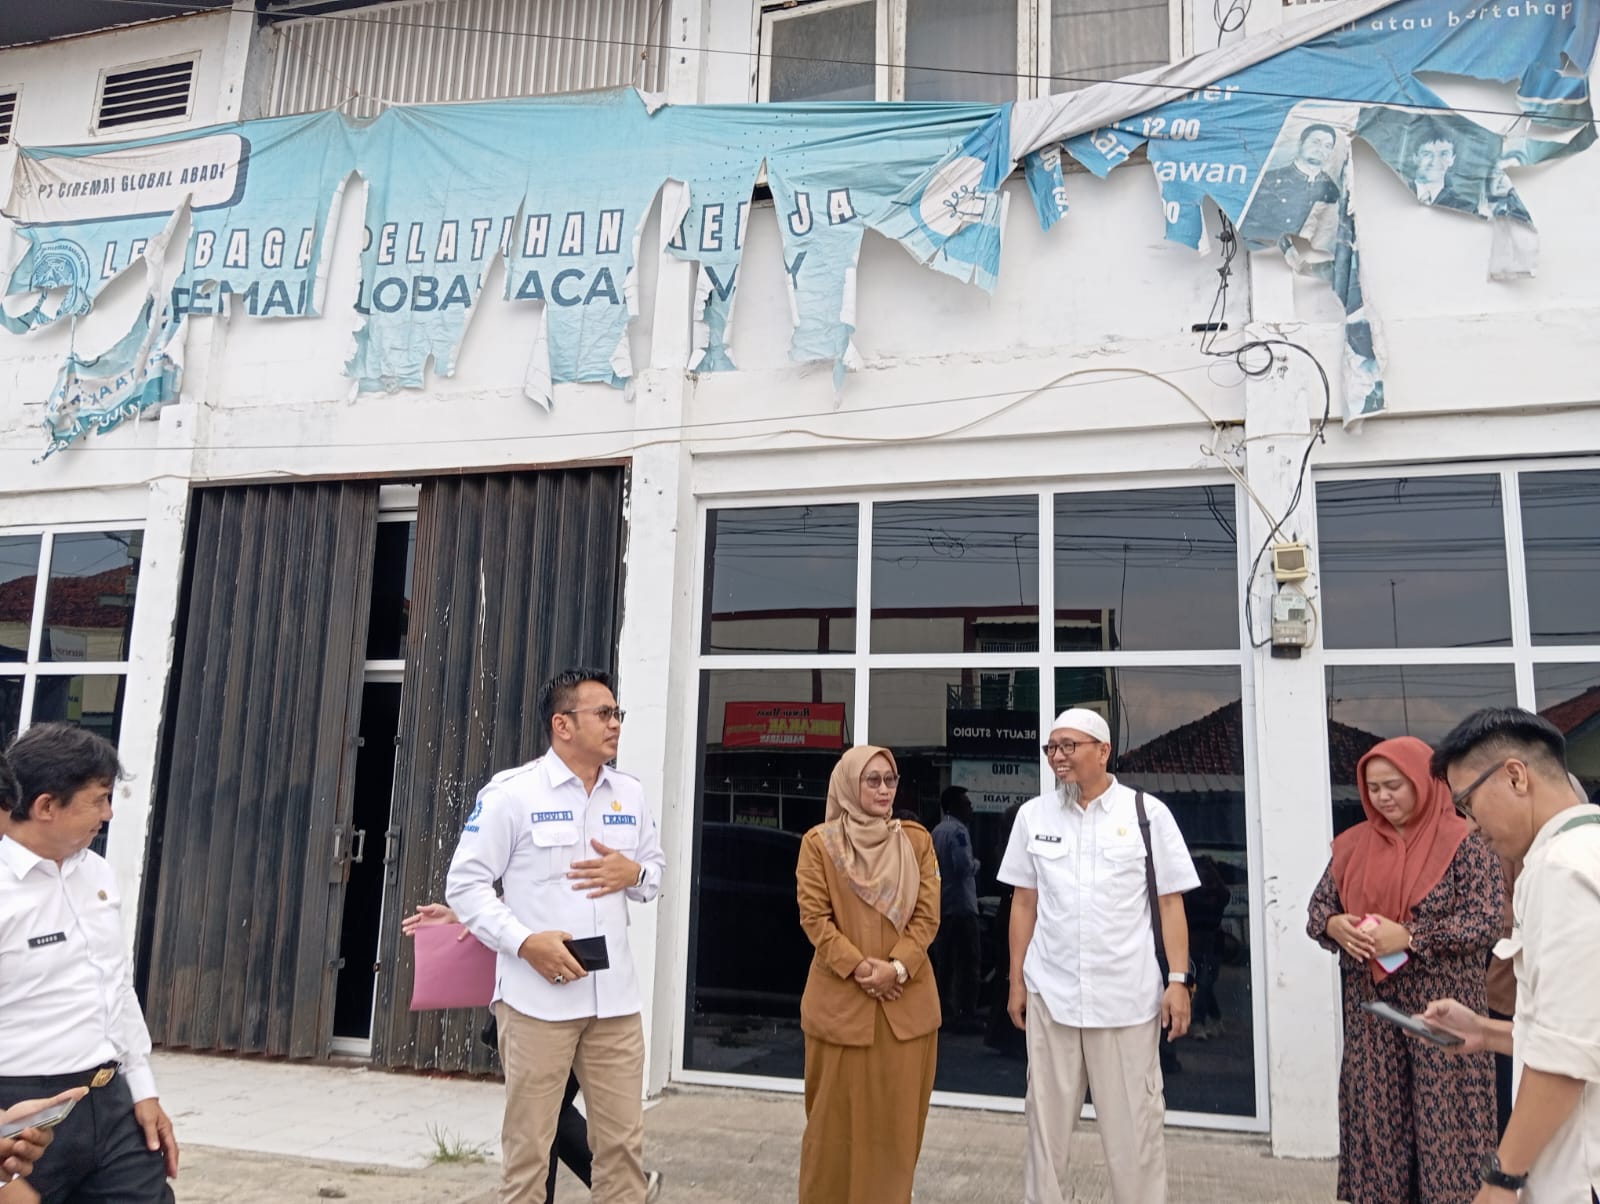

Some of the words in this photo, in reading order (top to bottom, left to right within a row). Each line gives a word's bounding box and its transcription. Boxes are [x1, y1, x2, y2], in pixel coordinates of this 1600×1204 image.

[1371, 17, 1433, 31] atau
[1142, 117, 1201, 141] 12.00
[58, 177, 115, 198] CIREMAI
[121, 170, 173, 192] GLOBAL
